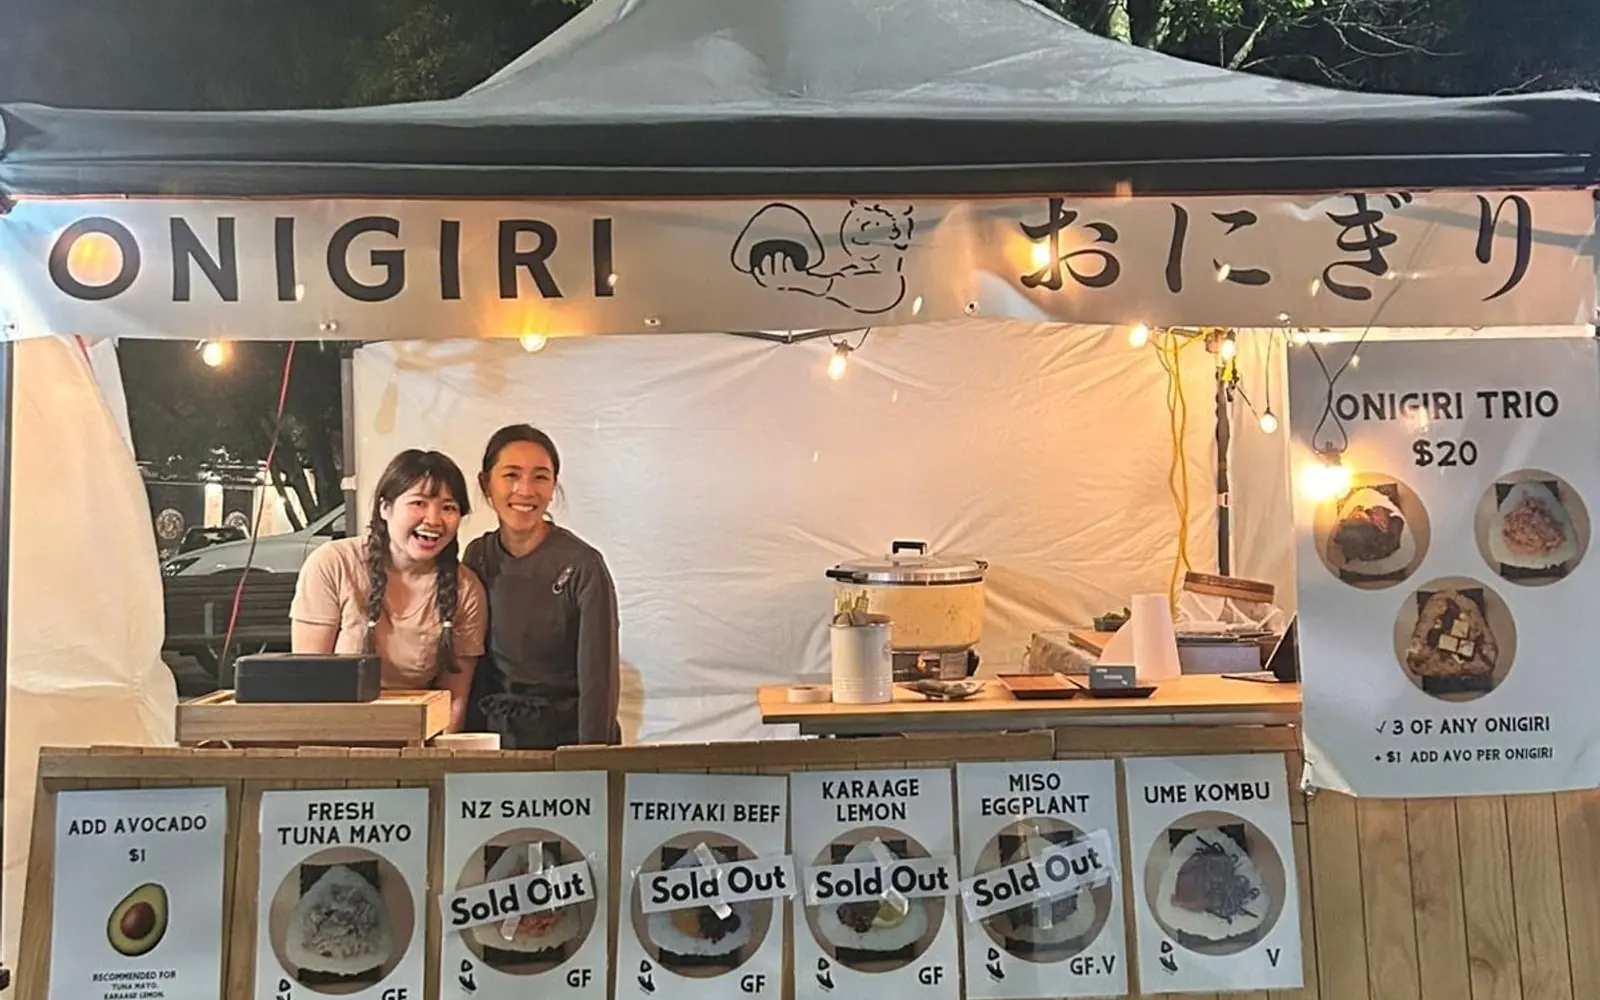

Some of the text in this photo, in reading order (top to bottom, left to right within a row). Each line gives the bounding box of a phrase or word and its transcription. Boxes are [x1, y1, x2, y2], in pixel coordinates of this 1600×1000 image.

[1019, 192, 1533, 301] おにぎり
[48, 216, 615, 303] ONIGIRI
[1335, 390, 1559, 421] ONIGIRI TRIO
[1412, 439, 1478, 467] $20
[1391, 715, 1550, 735] 3 OF ANY ONIGIRI
[1410, 750, 1439, 763] ADD
[1443, 749, 1473, 763] AVO
[1477, 748, 1501, 761] PER
[1505, 746, 1553, 760] ONIGIRI
[822, 778, 920, 800] KARAAGE
[1009, 773, 1061, 792] MISO
[1144, 781, 1271, 803] UME KOMBU
[307, 801, 375, 821] FRESH
[461, 798, 592, 818] NZ SALMON
[630, 802, 781, 823] TERIYAKI BEEF
[836, 802, 907, 822] LEMON
[981, 794, 1090, 816] EGGPLANT
[68, 815, 208, 836] ADD AVOCADO
[277, 824, 412, 846] TUNA MAYO
[128, 848, 146, 862] $1
[651, 865, 787, 904] Sold Out
[815, 865, 949, 899] Sold Out
[972, 847, 1103, 908] Sold Out
[450, 873, 586, 926] Sold Out
[1266, 948, 1281, 968] V
[93, 970, 176, 981] RECOMMENDED FOR
[566, 969, 592, 988] GF
[740, 974, 766, 993] GF
[918, 966, 944, 985] GF
[381, 988, 408, 1000] GF
